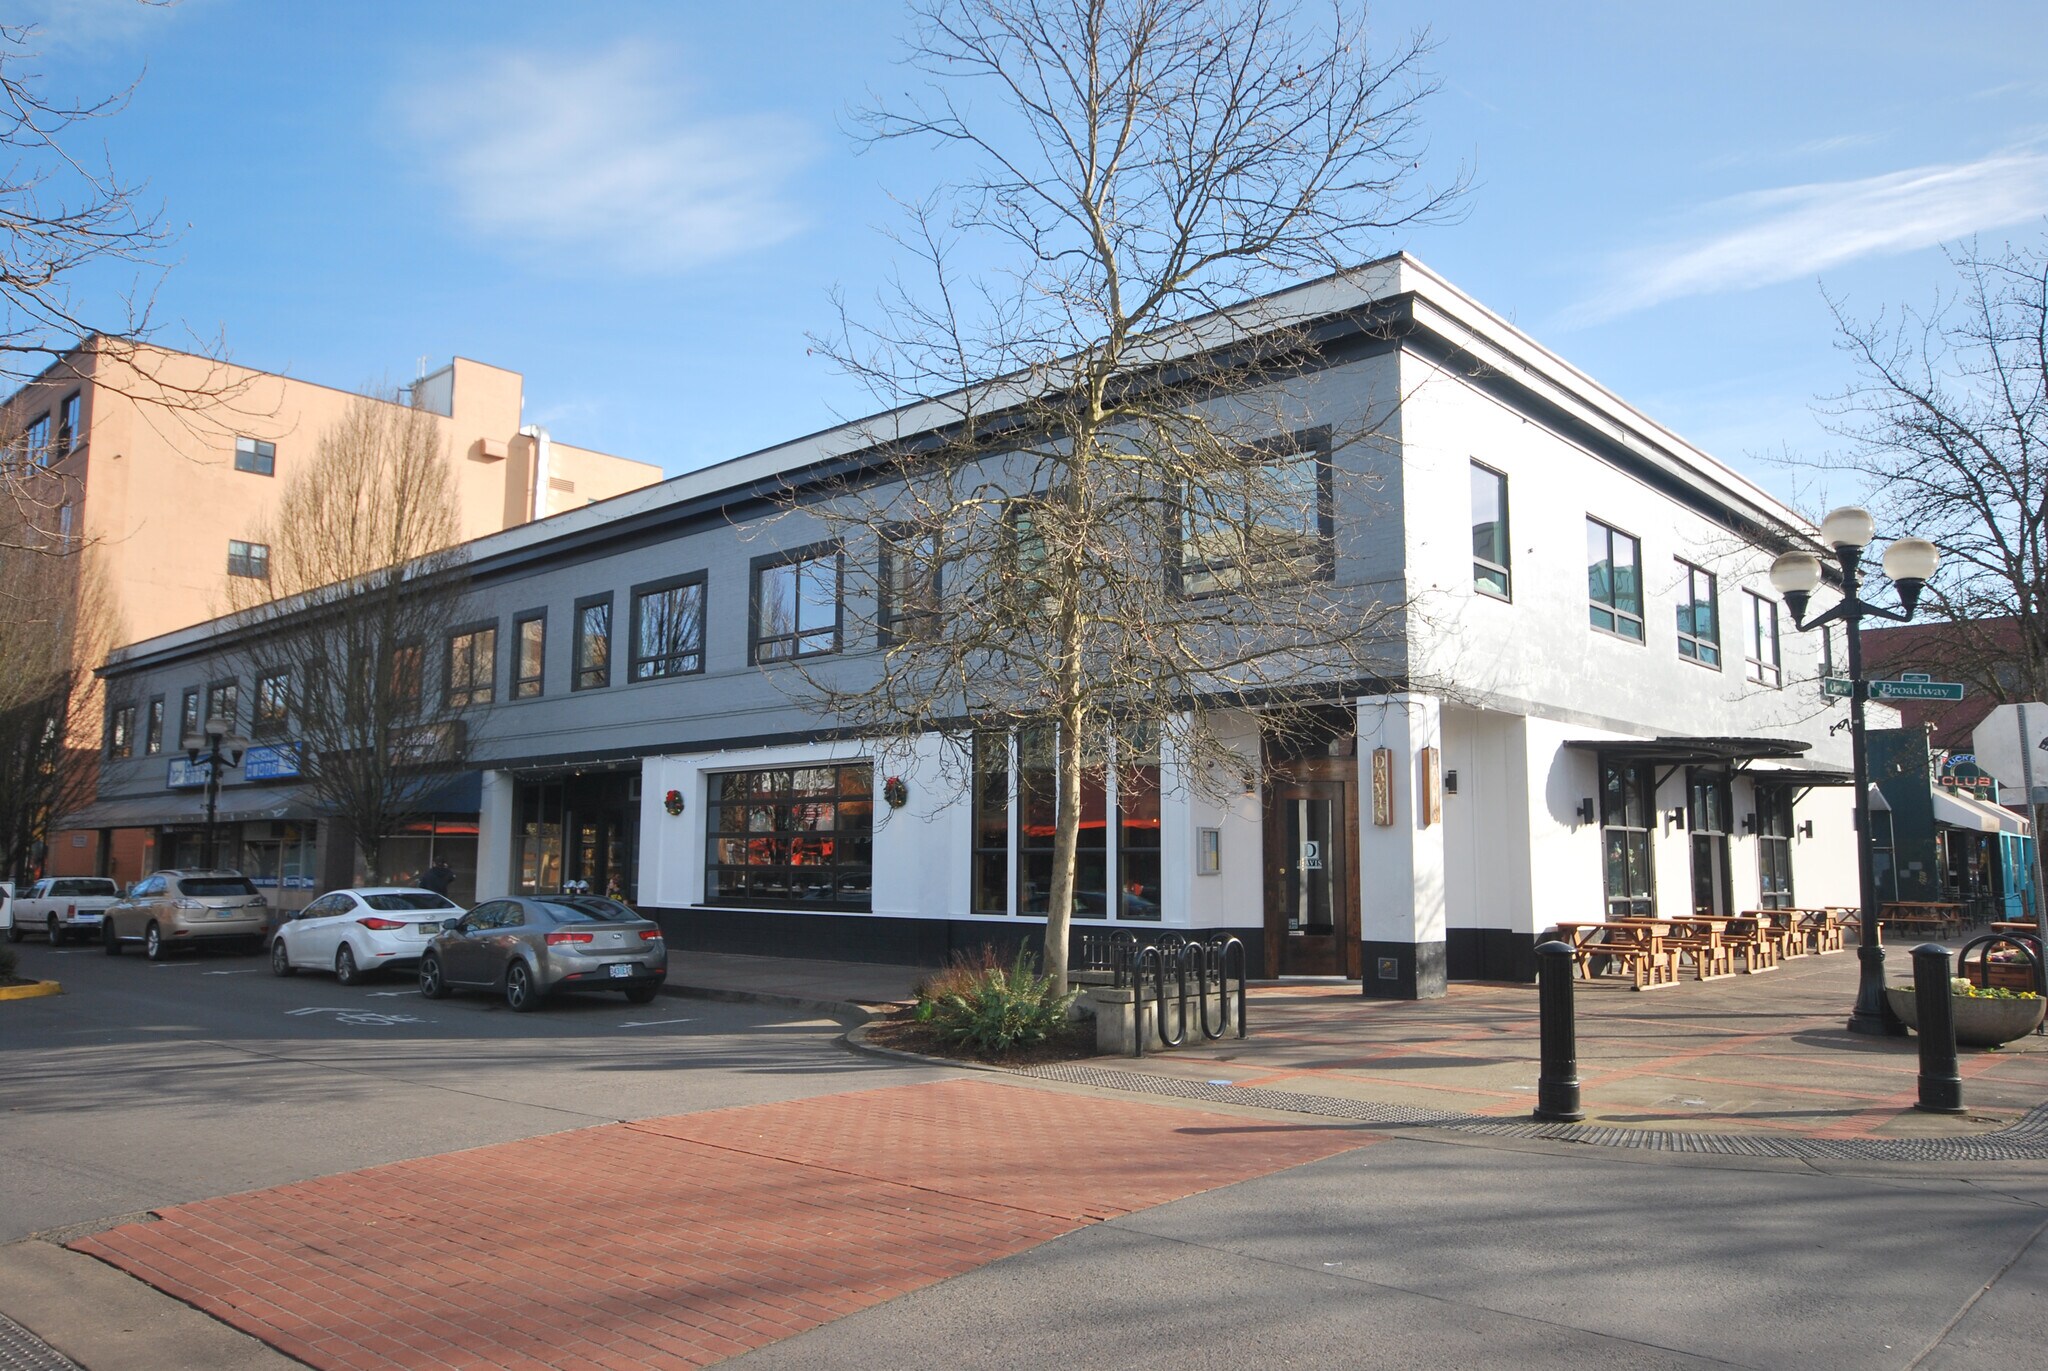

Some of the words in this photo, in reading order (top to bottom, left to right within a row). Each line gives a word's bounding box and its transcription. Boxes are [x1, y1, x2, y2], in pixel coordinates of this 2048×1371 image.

[1882, 683, 1949, 697] Broadway
[1375, 755, 1385, 822] DAVIS
[1941, 776, 1991, 787] CLUB
